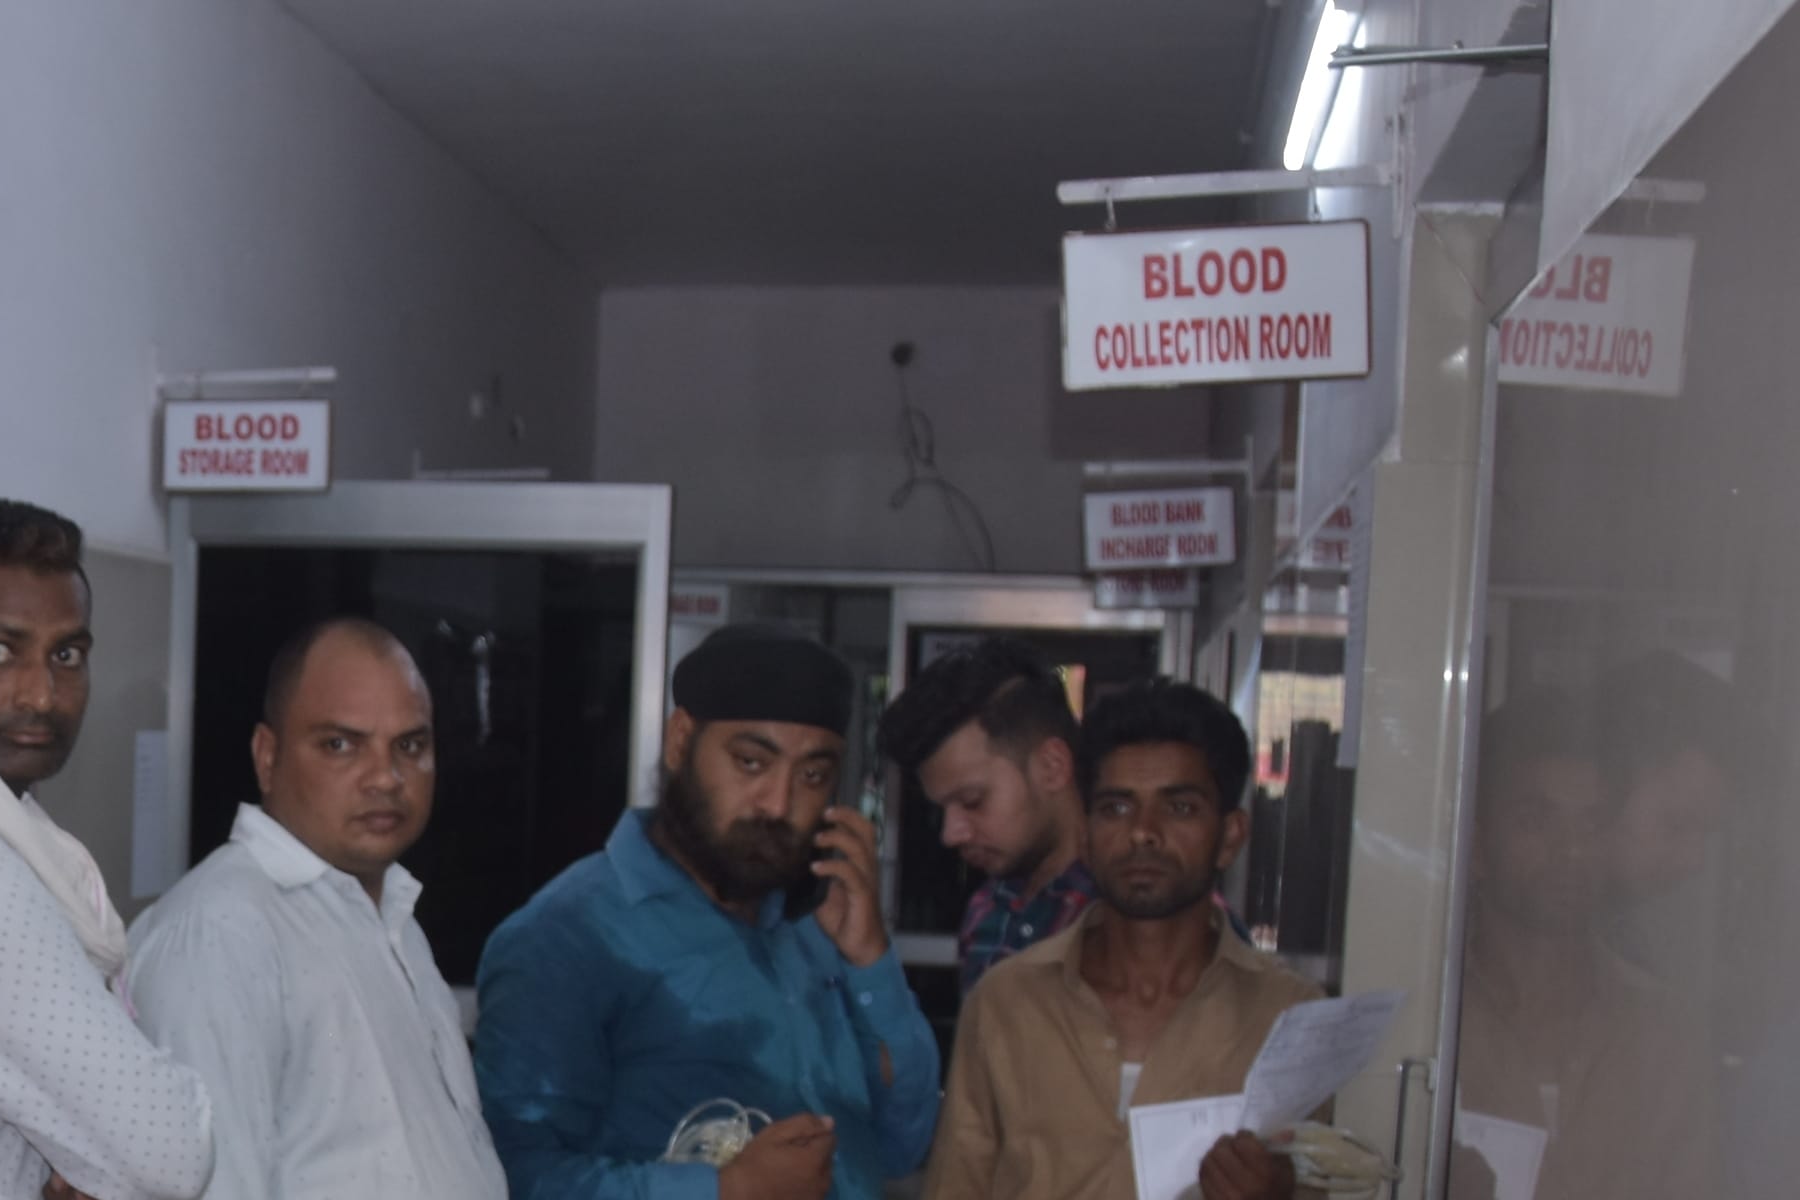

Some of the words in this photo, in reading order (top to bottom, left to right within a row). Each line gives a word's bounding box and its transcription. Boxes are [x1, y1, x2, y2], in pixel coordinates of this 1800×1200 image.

[1143, 247, 1288, 299] BLOOD
[1094, 315, 1251, 372] COLLECTION
[1259, 312, 1332, 360] ROOM
[195, 413, 301, 440] BLOOD
[179, 449, 255, 476] STORAGE
[261, 449, 309, 476] ROOM
[1111, 502, 1161, 528] BLOOD
[1165, 499, 1206, 525] BANK
[1176, 530, 1217, 557] ROOM
